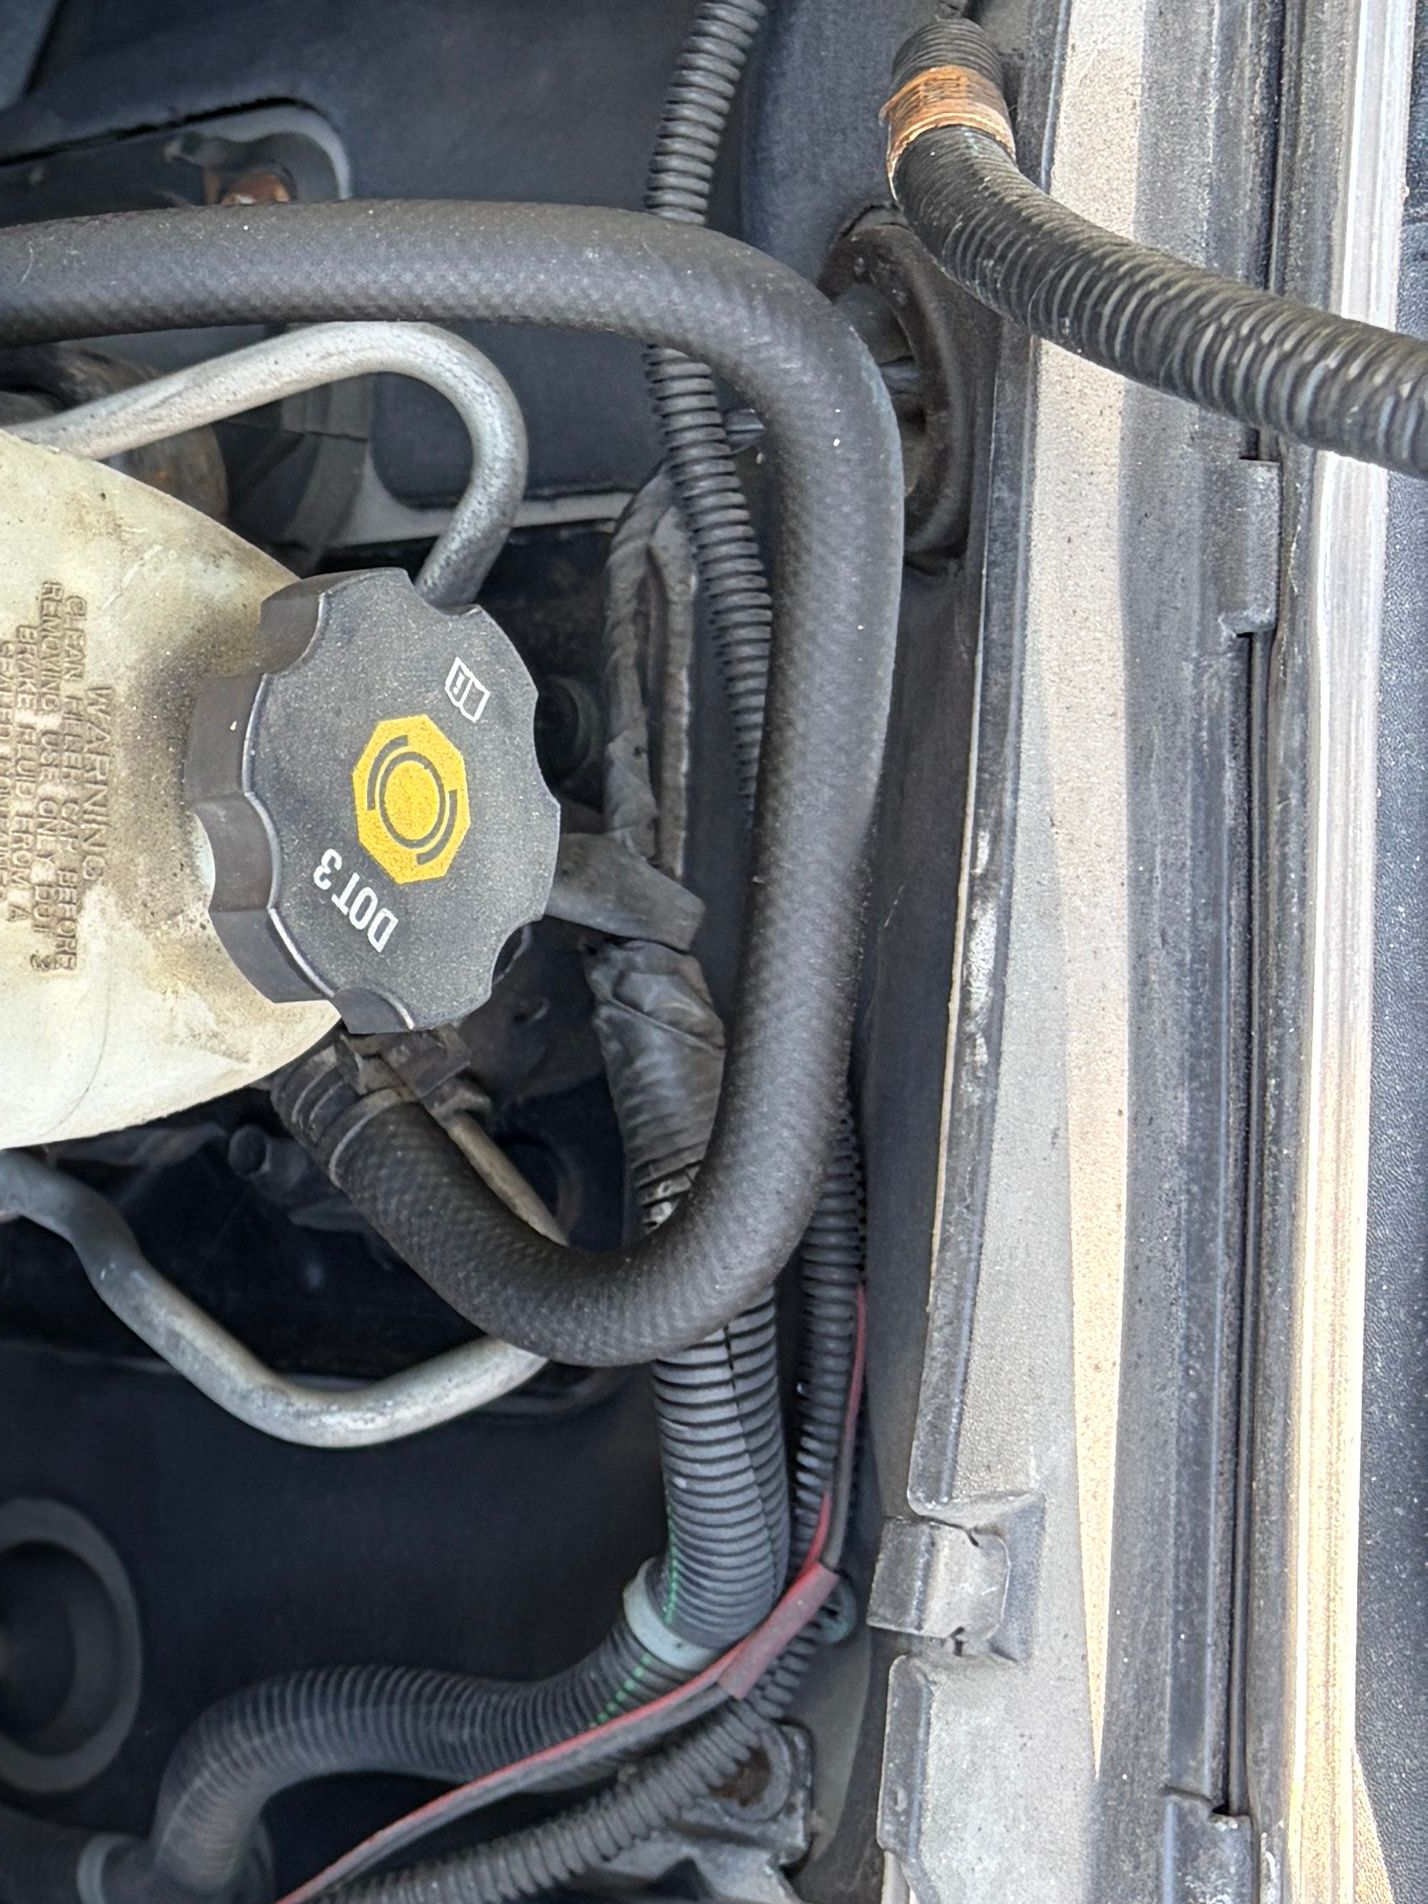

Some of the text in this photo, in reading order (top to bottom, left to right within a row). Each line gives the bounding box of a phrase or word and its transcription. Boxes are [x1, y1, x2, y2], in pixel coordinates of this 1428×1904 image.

[64, 595, 87, 681] CLEAN
[7, 626, 38, 922] BRAKE FLUID FROM A
[38, 730, 63, 782] USE
[60, 694, 85, 784] FILLER
[83, 687, 114, 881] WARNING
[36, 798, 59, 864] ONLY
[33, 883, 52, 934] DOT
[54, 868, 81, 970] BEFORE
[313, 848, 399, 953] DOT 3
[30, 954, 53, 972] 3
